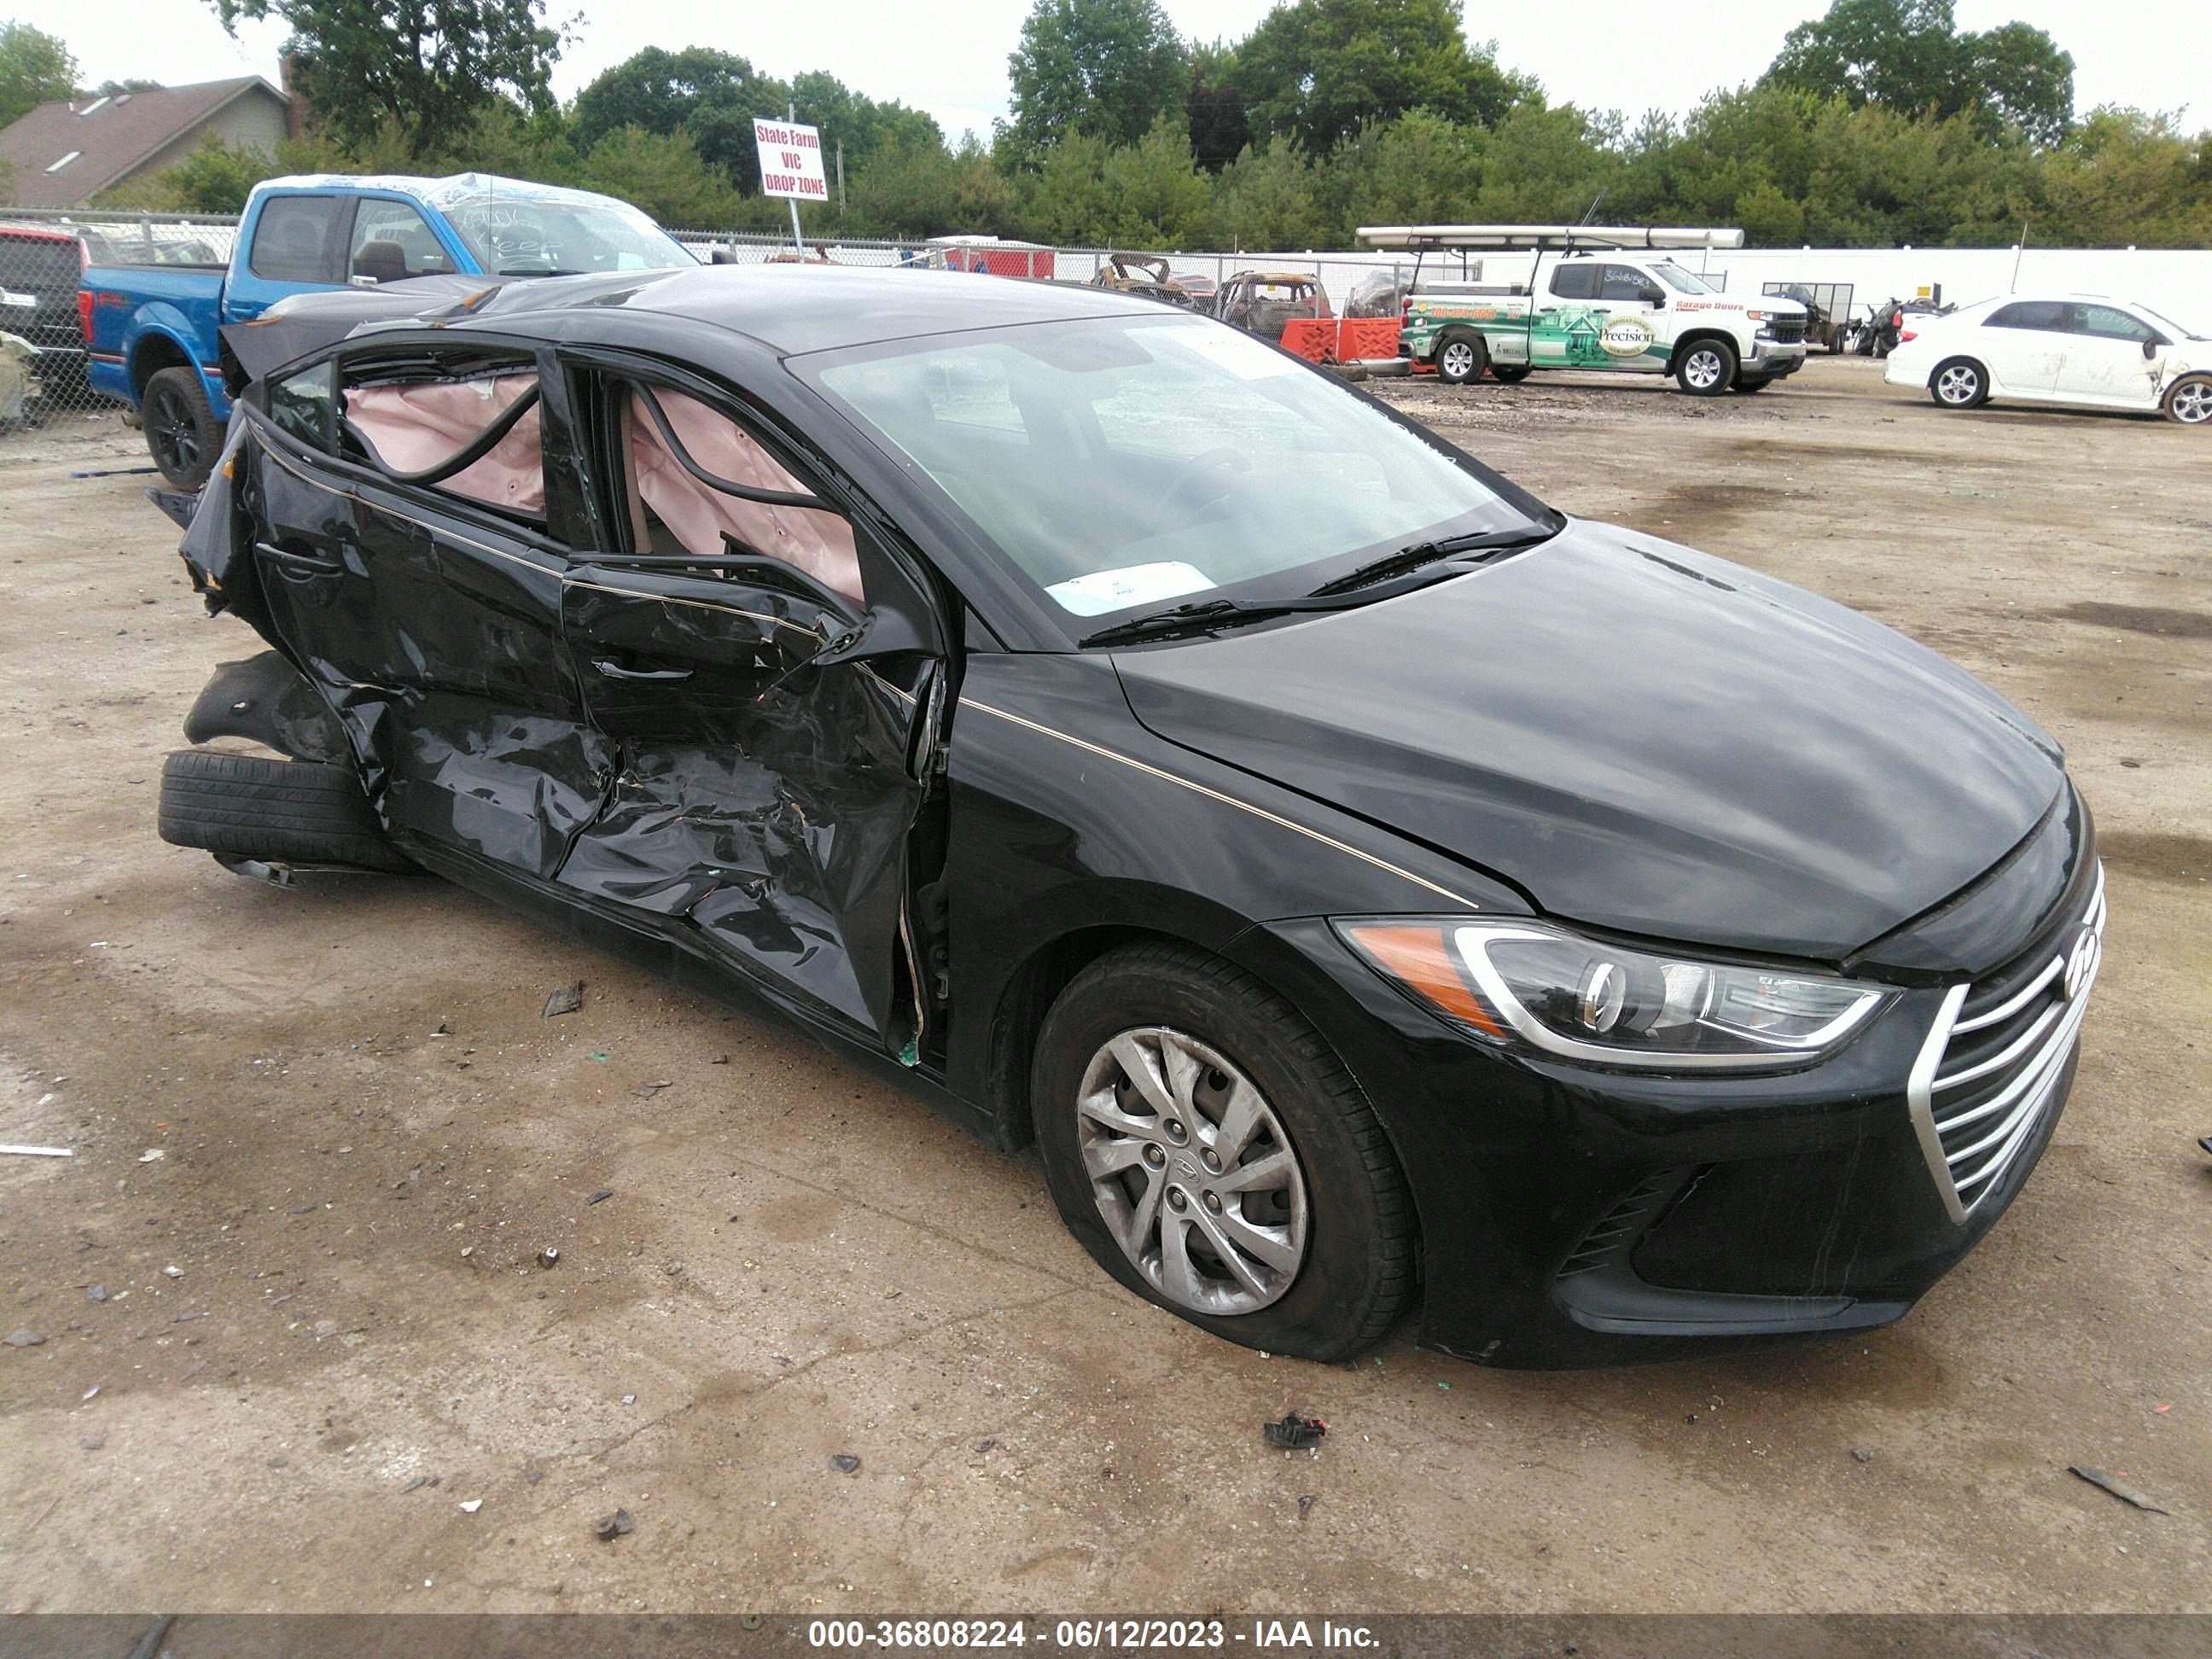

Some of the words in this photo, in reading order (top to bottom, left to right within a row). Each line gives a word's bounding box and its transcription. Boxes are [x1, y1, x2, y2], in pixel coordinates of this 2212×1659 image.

[757, 125, 789, 144] State
[789, 130, 818, 148] Farm
[781, 152, 801, 170] VIC
[765, 173, 795, 192] DROP
[797, 177, 825, 195] ZONE
[1676, 300, 1713, 310] Garage
[1598, 328, 1654, 342] Precision
